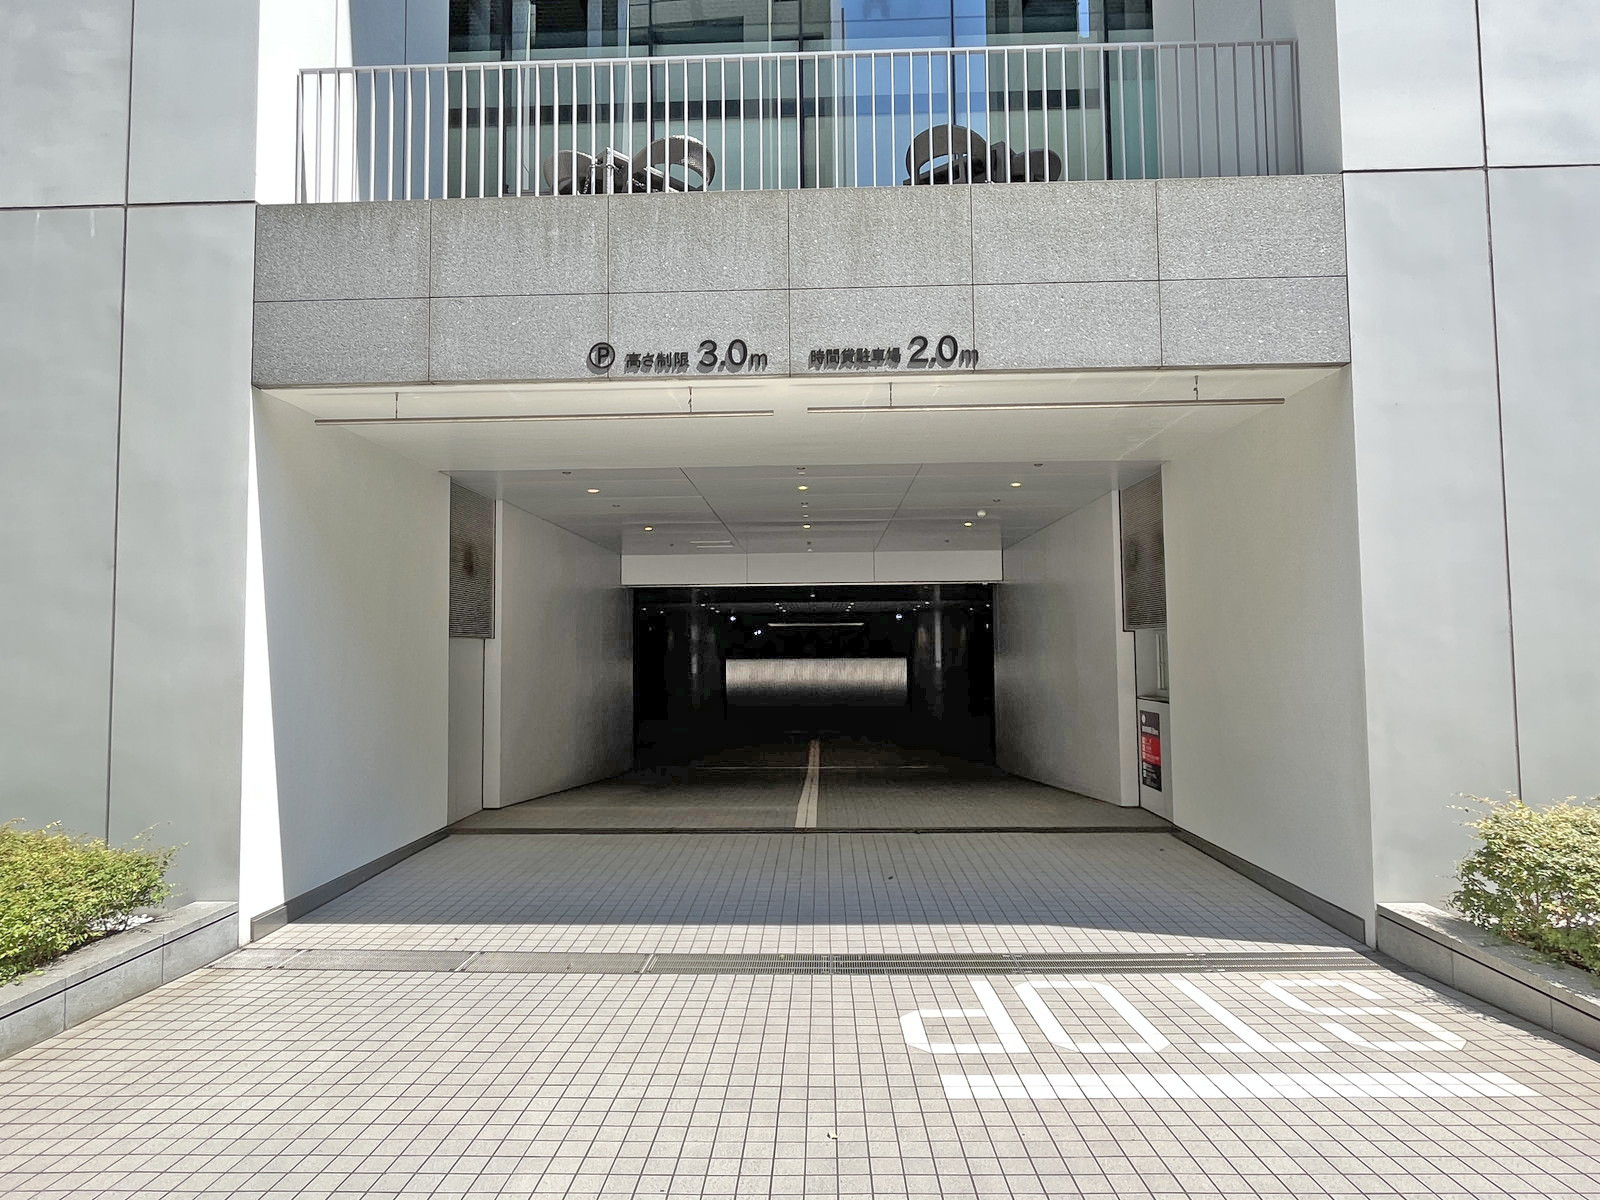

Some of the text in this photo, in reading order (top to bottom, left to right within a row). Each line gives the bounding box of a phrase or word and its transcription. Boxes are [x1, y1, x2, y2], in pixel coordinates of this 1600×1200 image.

[626, 351, 690, 368] 高さ制限
[699, 339, 768, 368] 3.0m
[810, 347, 901, 365] 時間貸駐車場
[908, 335, 979, 363] 2.0m
[899, 980, 1468, 1054] STOP
